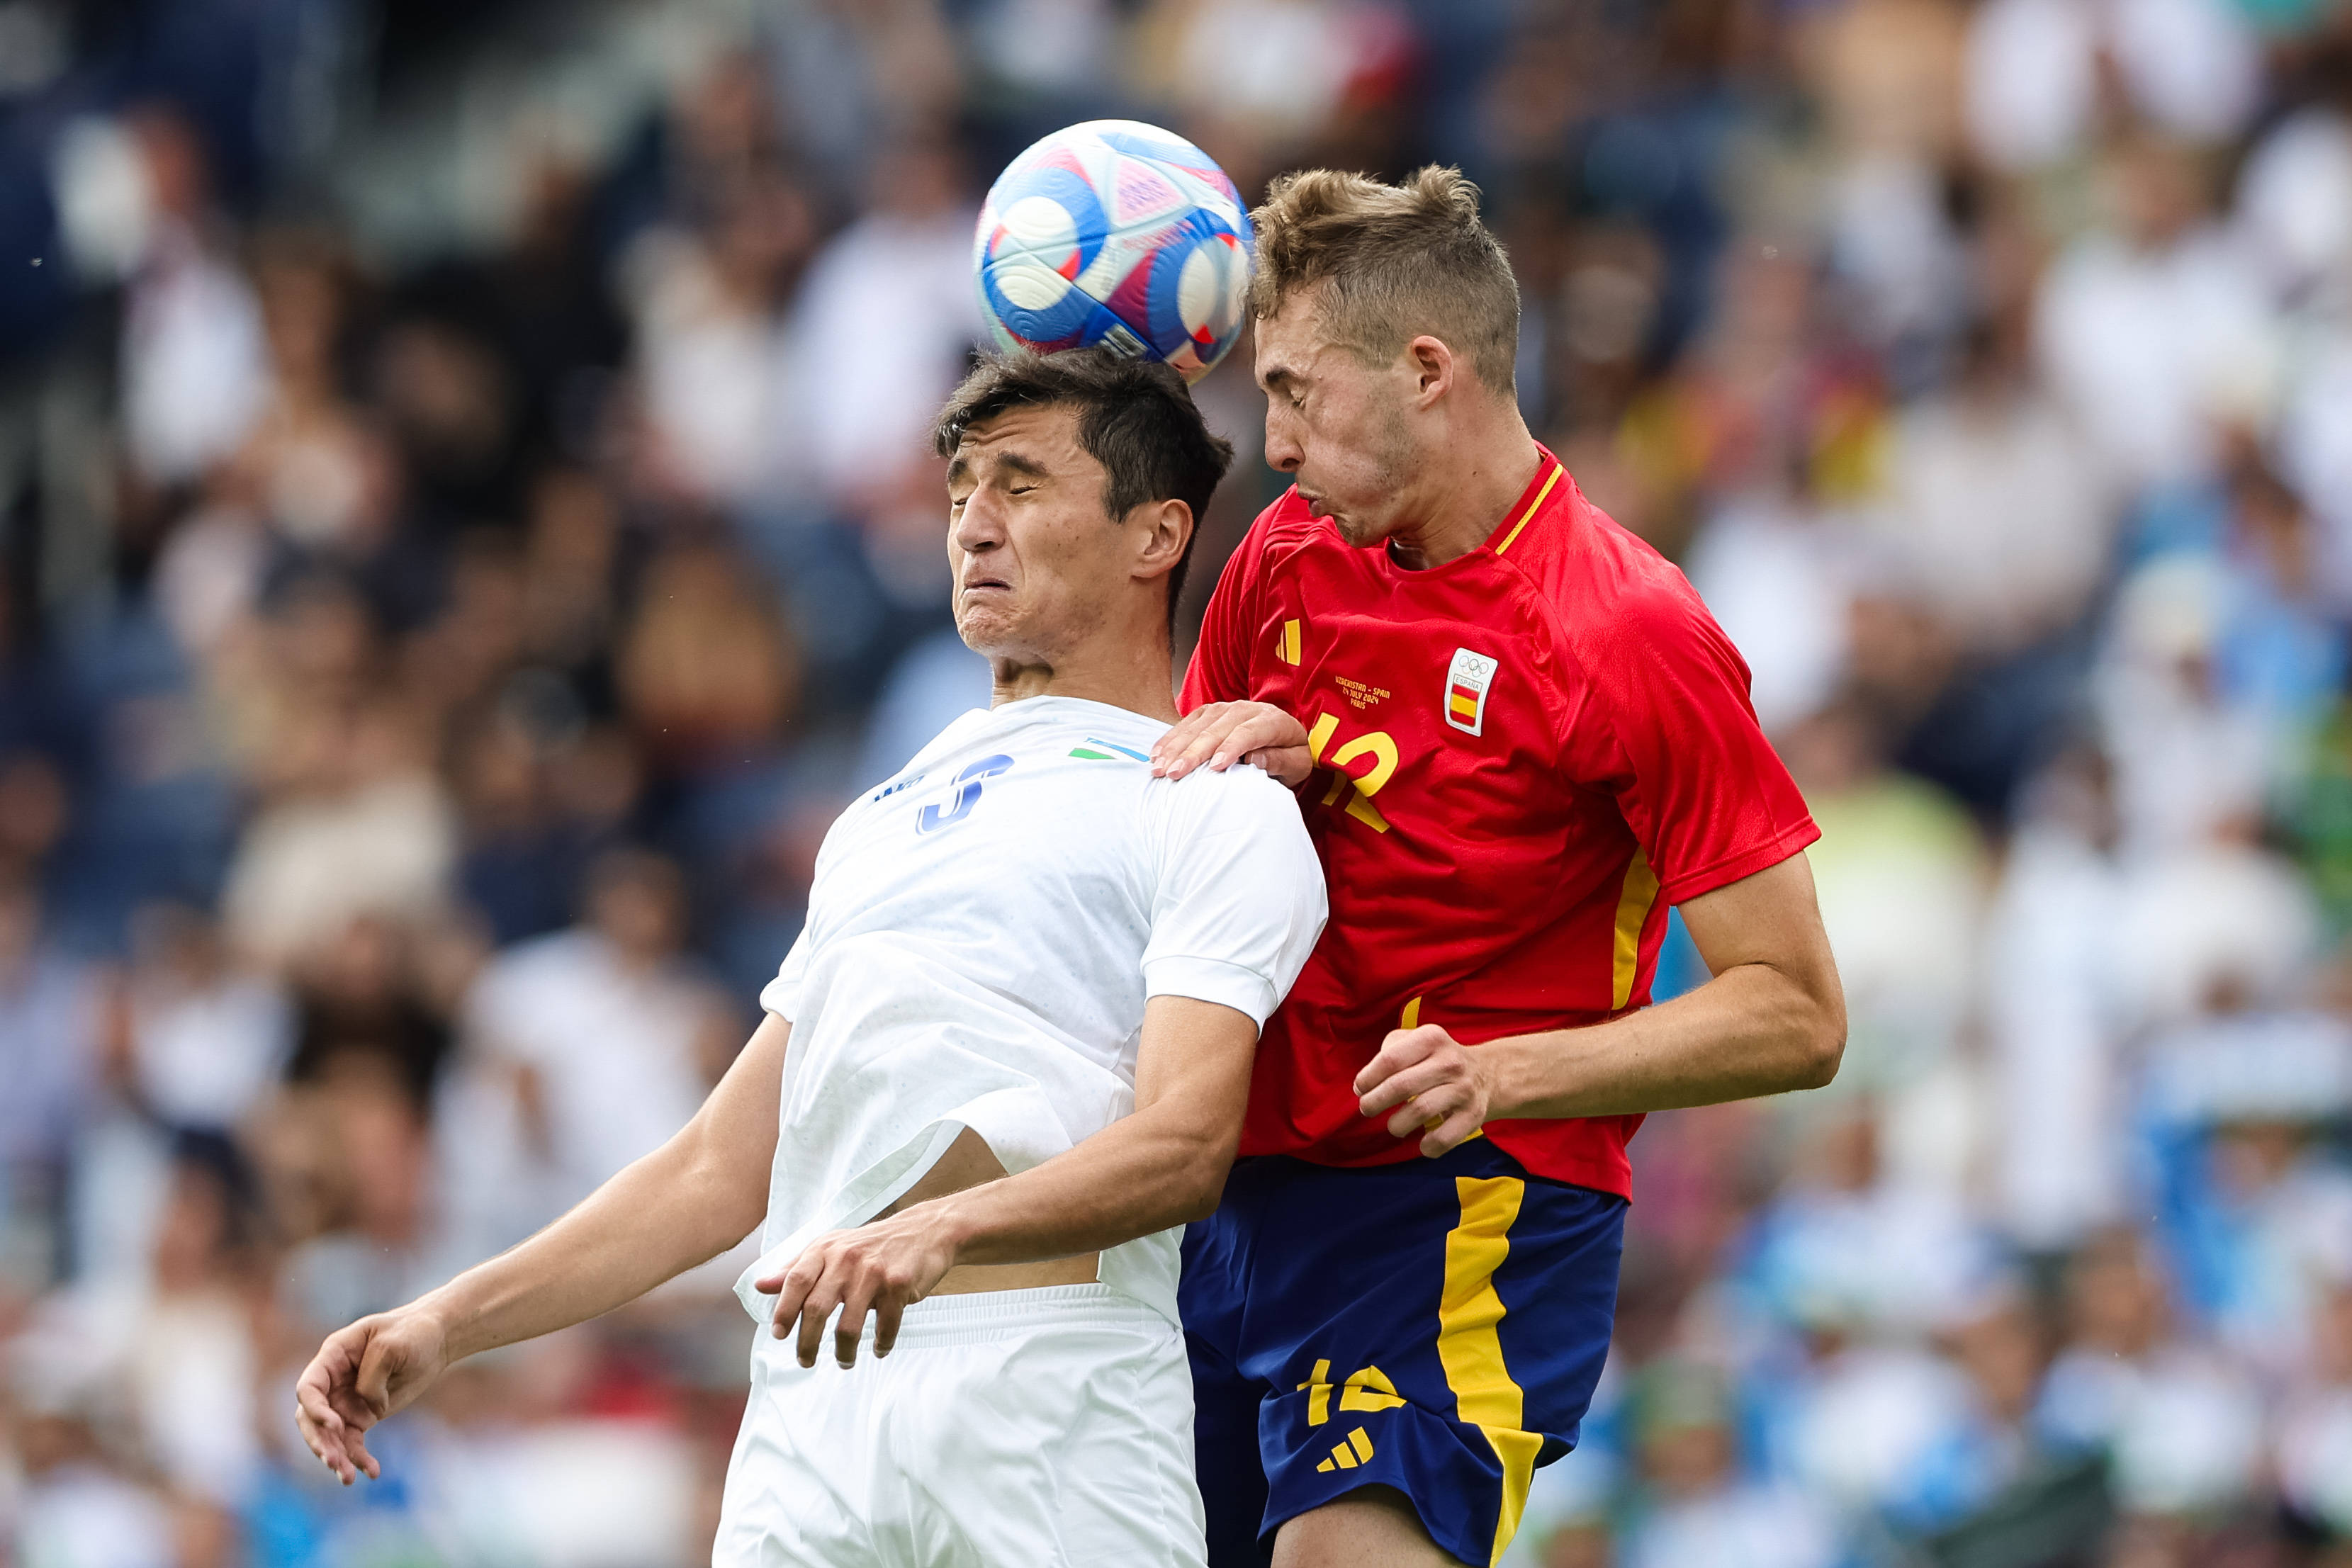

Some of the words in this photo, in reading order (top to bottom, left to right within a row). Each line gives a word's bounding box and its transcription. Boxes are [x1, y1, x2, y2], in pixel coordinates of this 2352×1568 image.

[1342, 686, 1349, 696] 24
[1349, 689, 1363, 699] JULY
[1363, 694, 1379, 705] 2024
[1373, 687, 1390, 699] SPAIN
[1351, 698, 1366, 710] PARIS
[1307, 711, 1399, 833] 12
